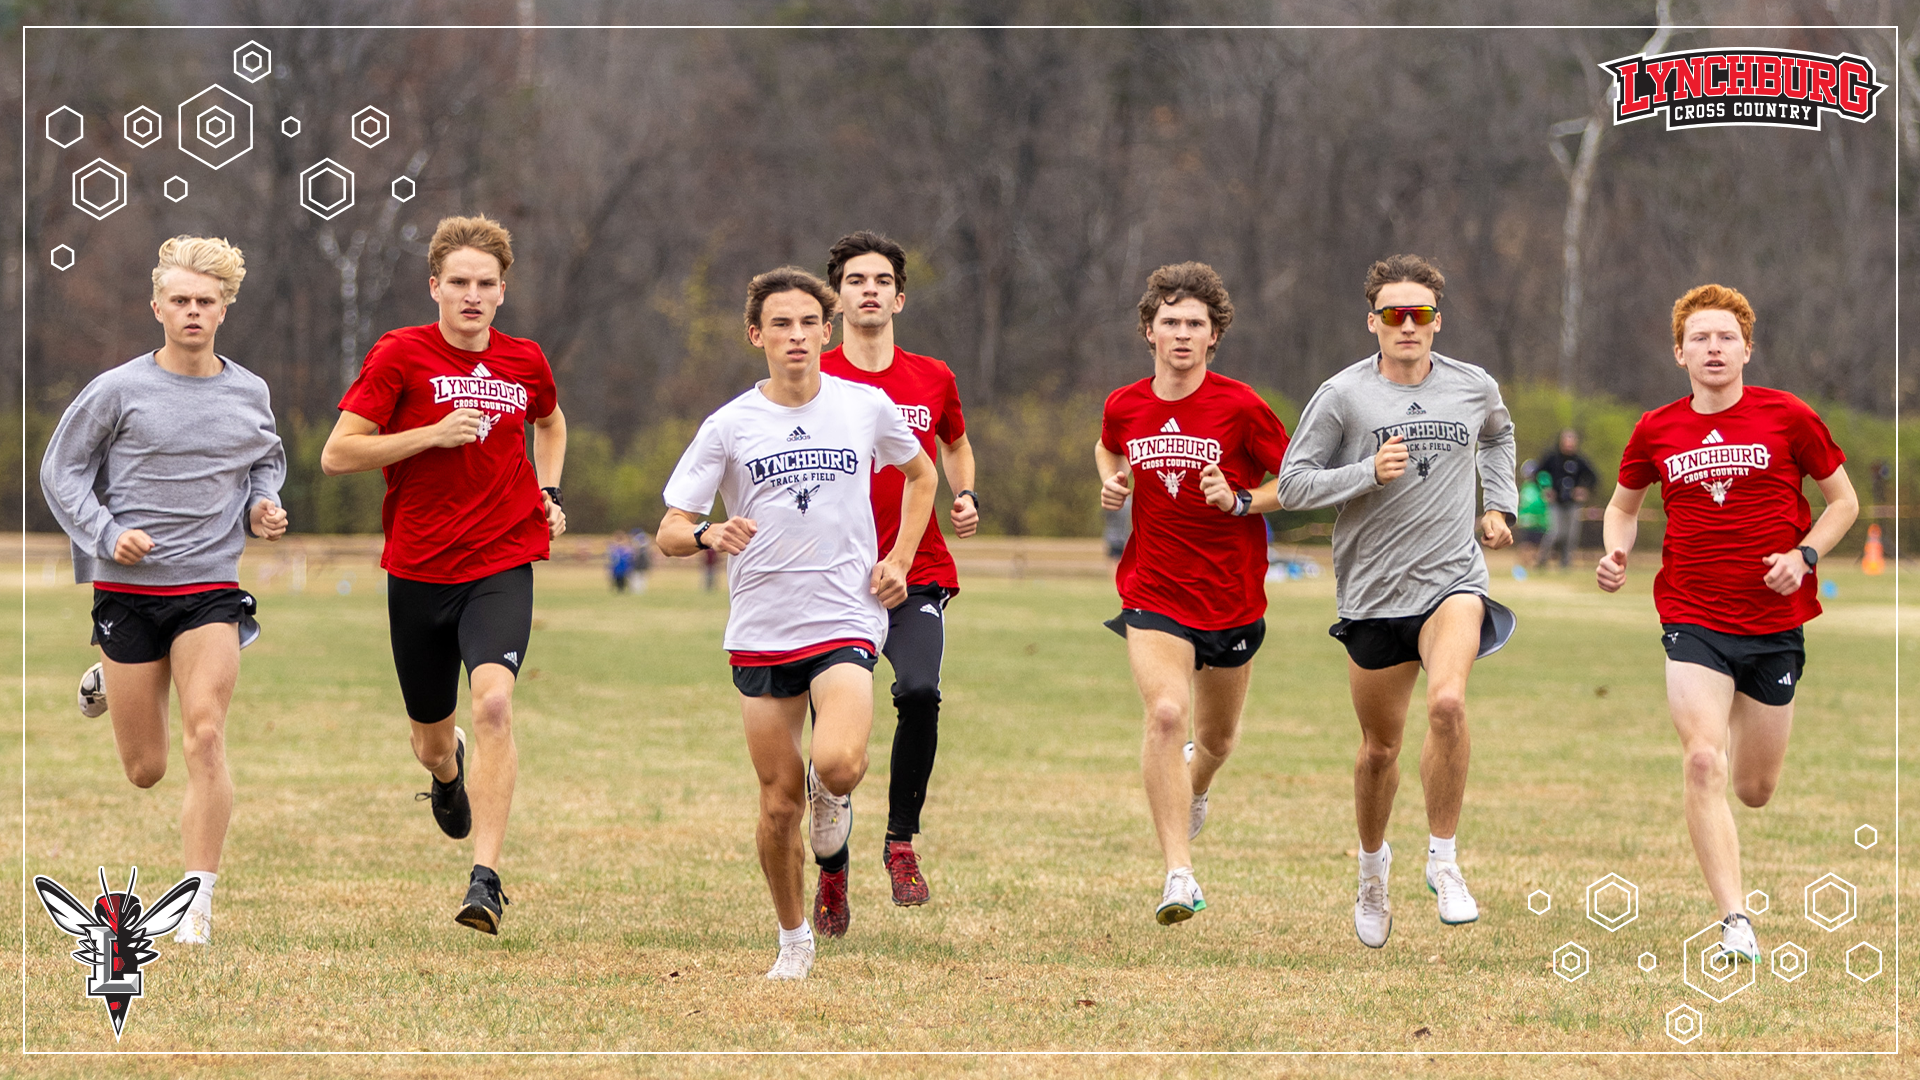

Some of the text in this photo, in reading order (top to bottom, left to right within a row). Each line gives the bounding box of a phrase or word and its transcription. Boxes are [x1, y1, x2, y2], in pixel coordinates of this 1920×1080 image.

[435, 378, 528, 409] LYNCHBURG
[453, 399, 516, 415] CROSS COUNTRY
[1128, 437, 1219, 463] LYNCHBURG
[1429, 442, 1452, 452] FIELD
[748, 450, 857, 484] LYNCHBURG
[1141, 458, 1202, 470] CROSS COUNTRY
[1667, 446, 1767, 479] LYNCHBURG
[770, 472, 836, 488] TRACK & FIELD
[1683, 467, 1750, 484] CROSS COUNTRY
